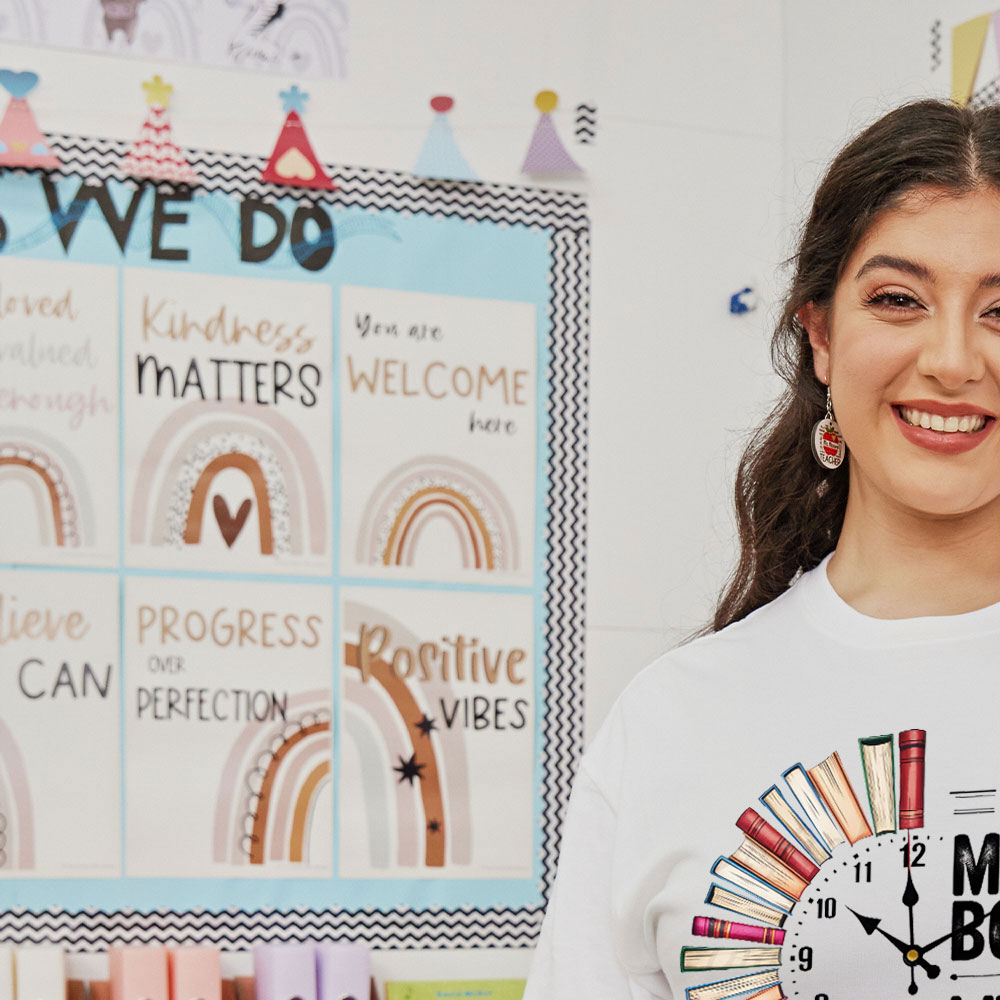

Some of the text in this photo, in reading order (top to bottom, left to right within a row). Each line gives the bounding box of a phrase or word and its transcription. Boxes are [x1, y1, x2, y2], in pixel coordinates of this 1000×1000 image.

[41, 173, 190, 261] WE
[240, 196, 335, 272] DO
[142, 295, 317, 354] Kindness
[354, 312, 444, 342] You are
[136, 354, 323, 407] MATTERS
[347, 355, 529, 405] WELCOME
[468, 410, 517, 434] here
[137, 605, 323, 649] PROGRESS
[149, 655, 186, 675] OVER
[360, 623, 528, 685] Positive
[18, 657, 114, 700] CAN
[136, 686, 289, 723] PERFECTION
[440, 696, 529, 730] VIBES
[852, 861, 874, 884] 11
[899, 842, 927, 868] 12
[816, 897, 838, 919] 10
[798, 946, 814, 972] 9
